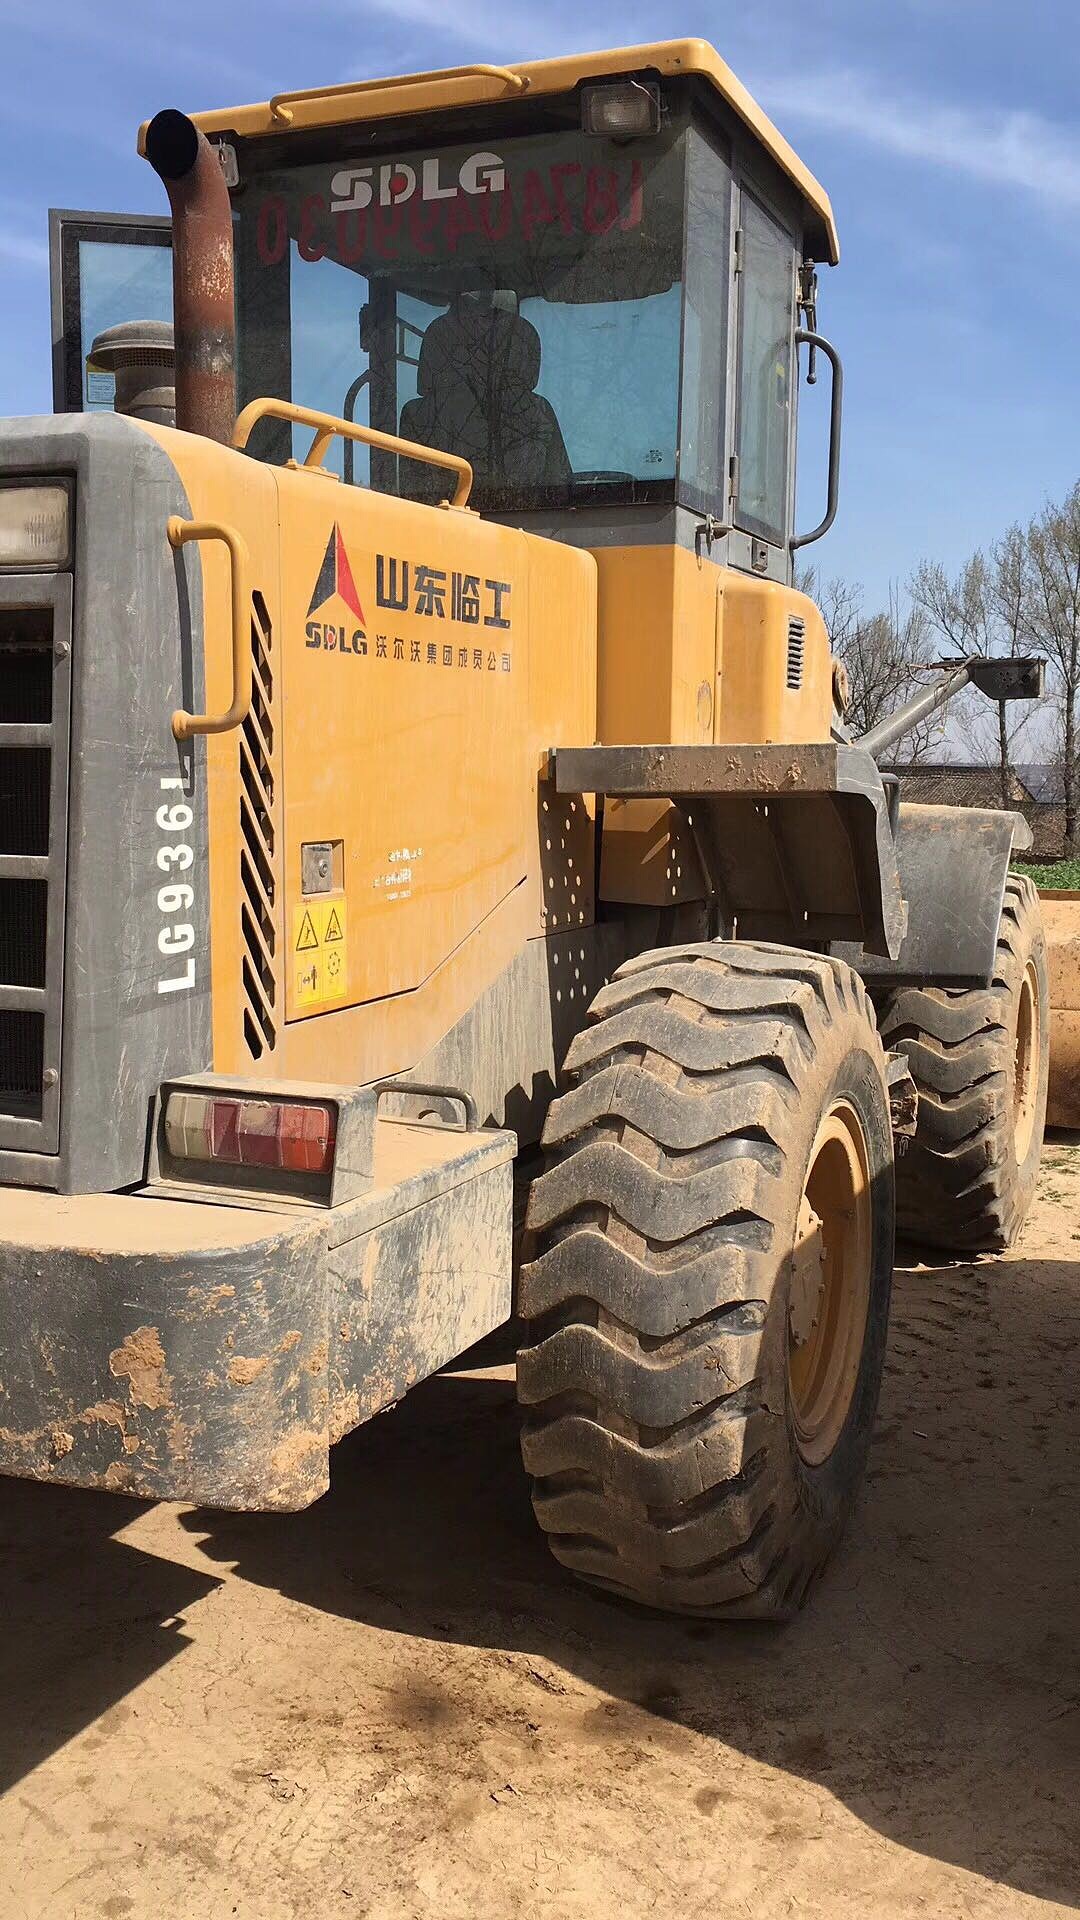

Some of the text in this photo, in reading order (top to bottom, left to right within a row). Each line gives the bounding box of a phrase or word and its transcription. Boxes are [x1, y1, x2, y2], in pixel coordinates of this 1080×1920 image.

[330, 151, 506, 214] SDLG
[375, 553, 512, 630] 山东临工
[305, 621, 369, 656] SDLG
[375, 634, 512, 673] 沃尔沃集团成员公司
